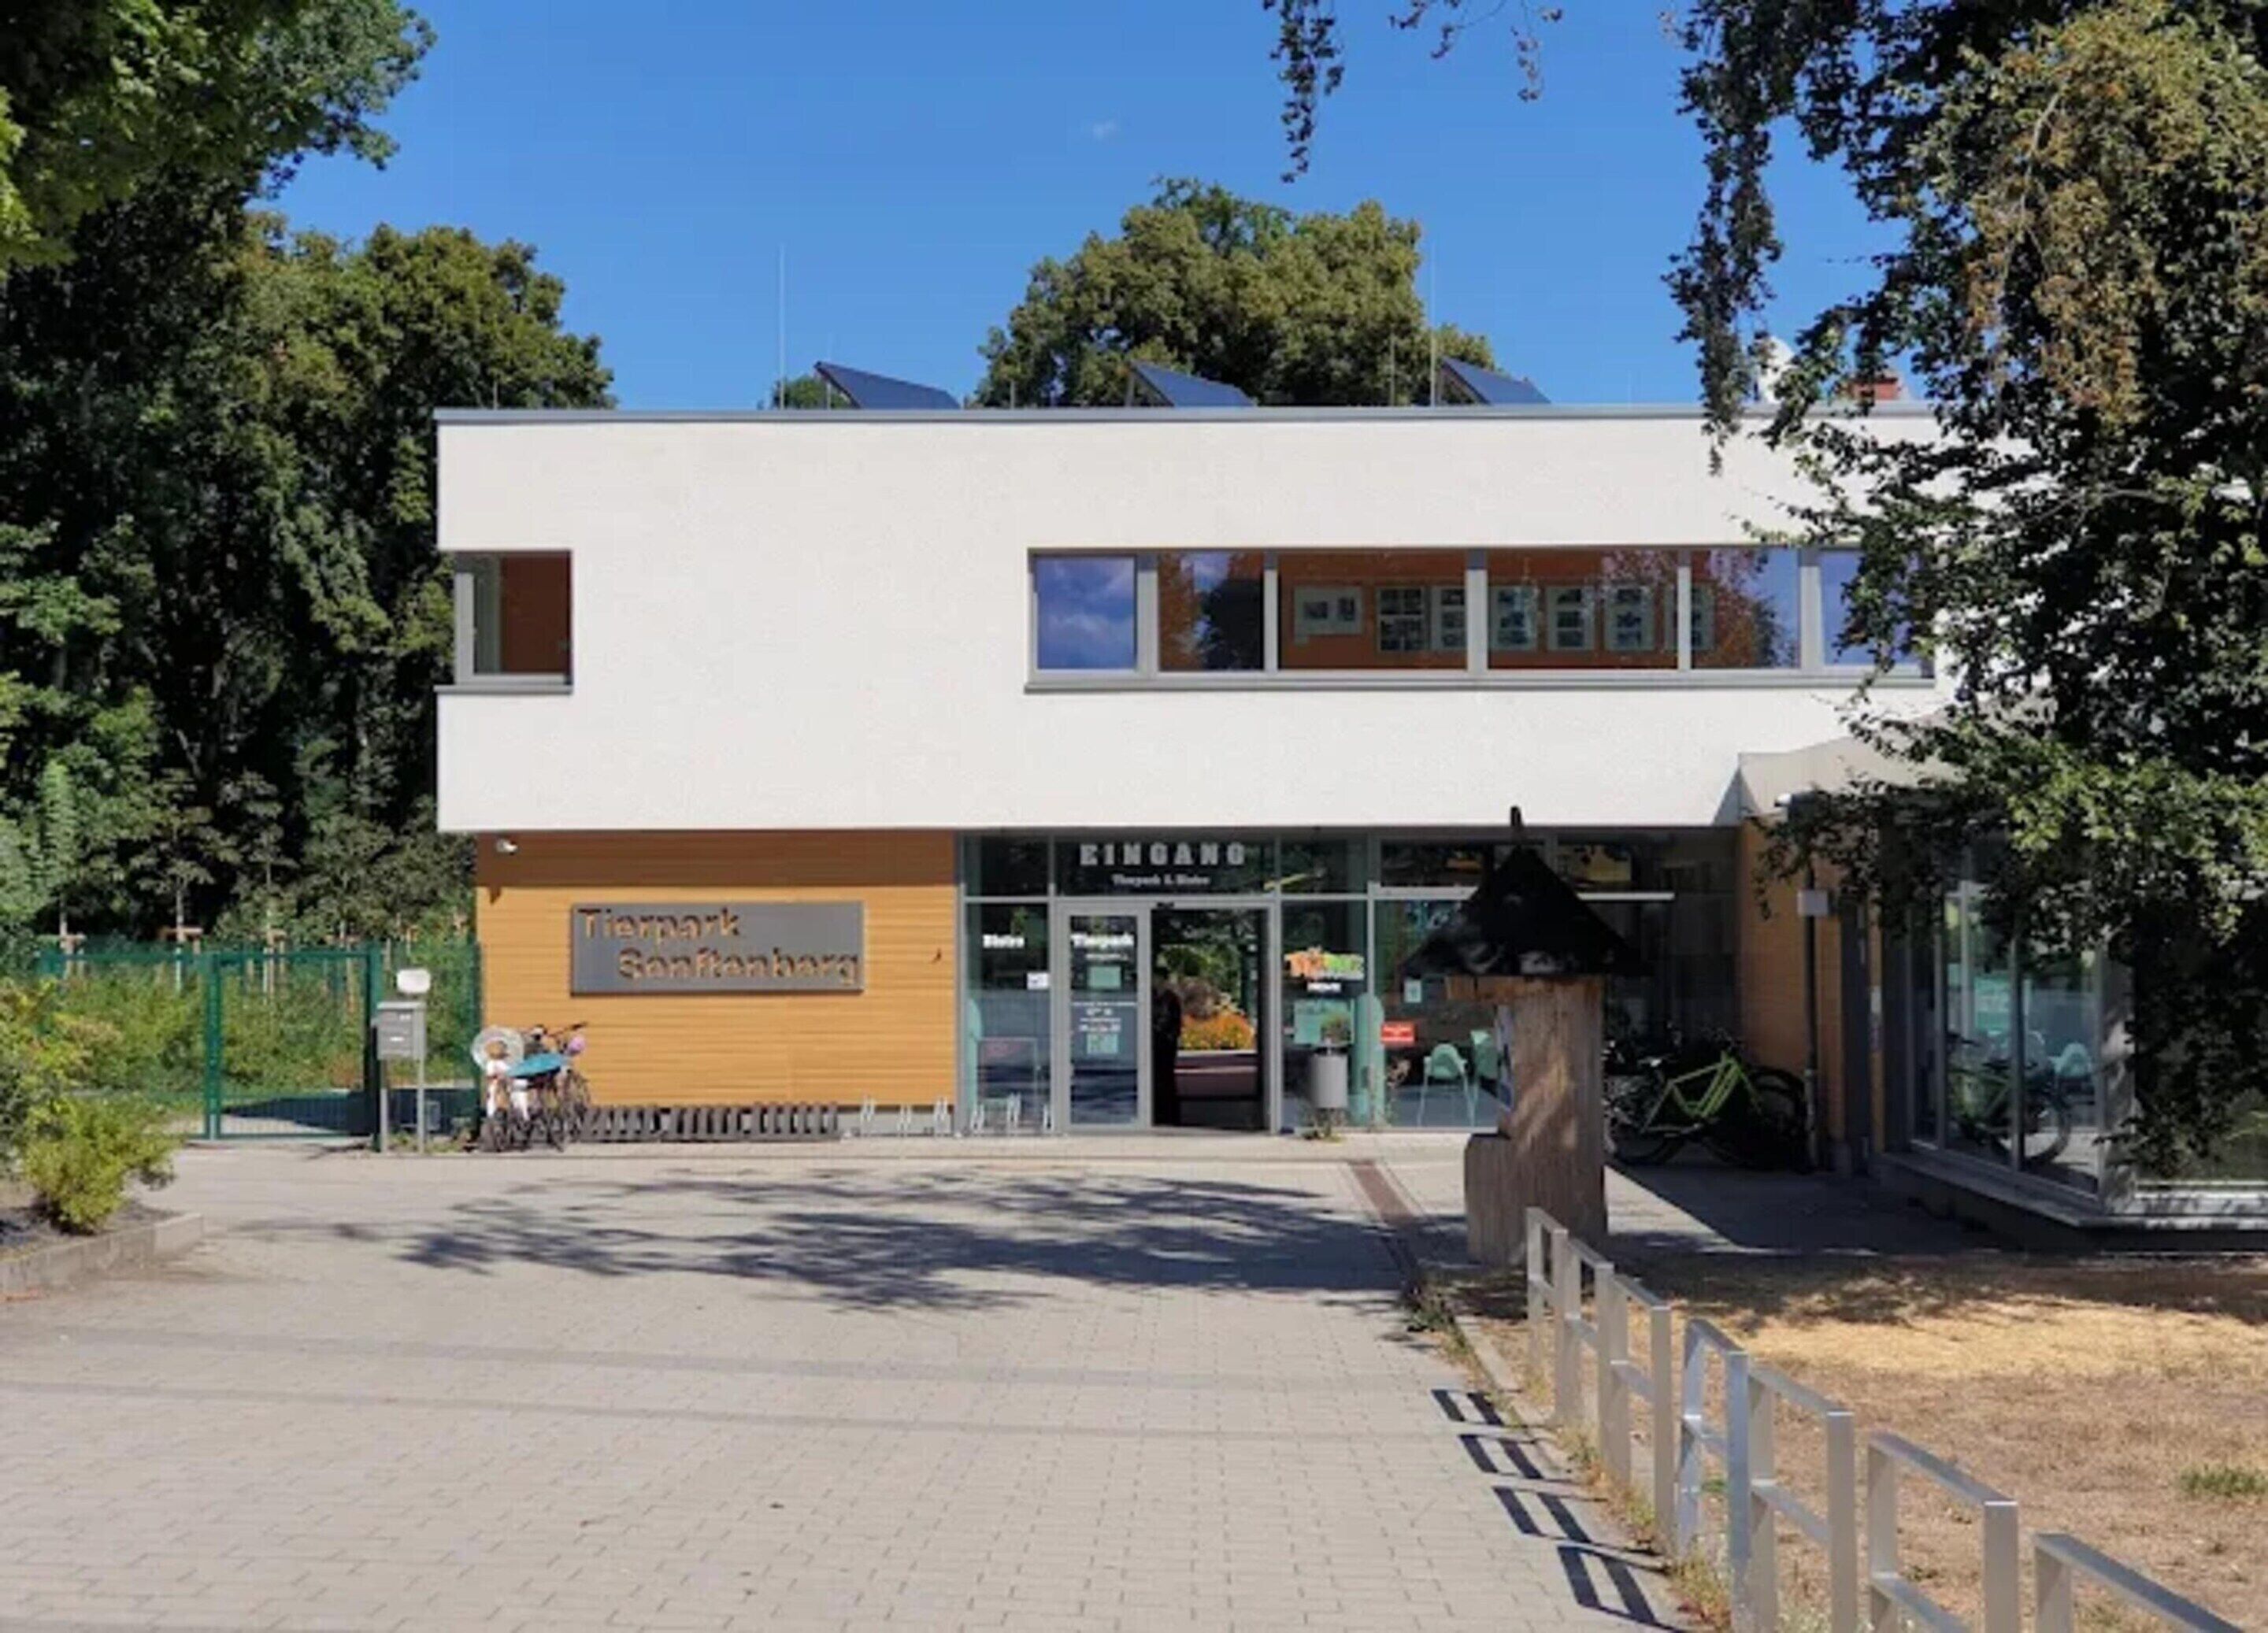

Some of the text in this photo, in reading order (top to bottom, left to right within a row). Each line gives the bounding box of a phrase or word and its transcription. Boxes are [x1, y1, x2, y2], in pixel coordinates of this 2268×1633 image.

[1079, 842, 1245, 866] EINGANG
[577, 907, 740, 942] Tierpark
[619, 947, 858, 986] Senftenberg
